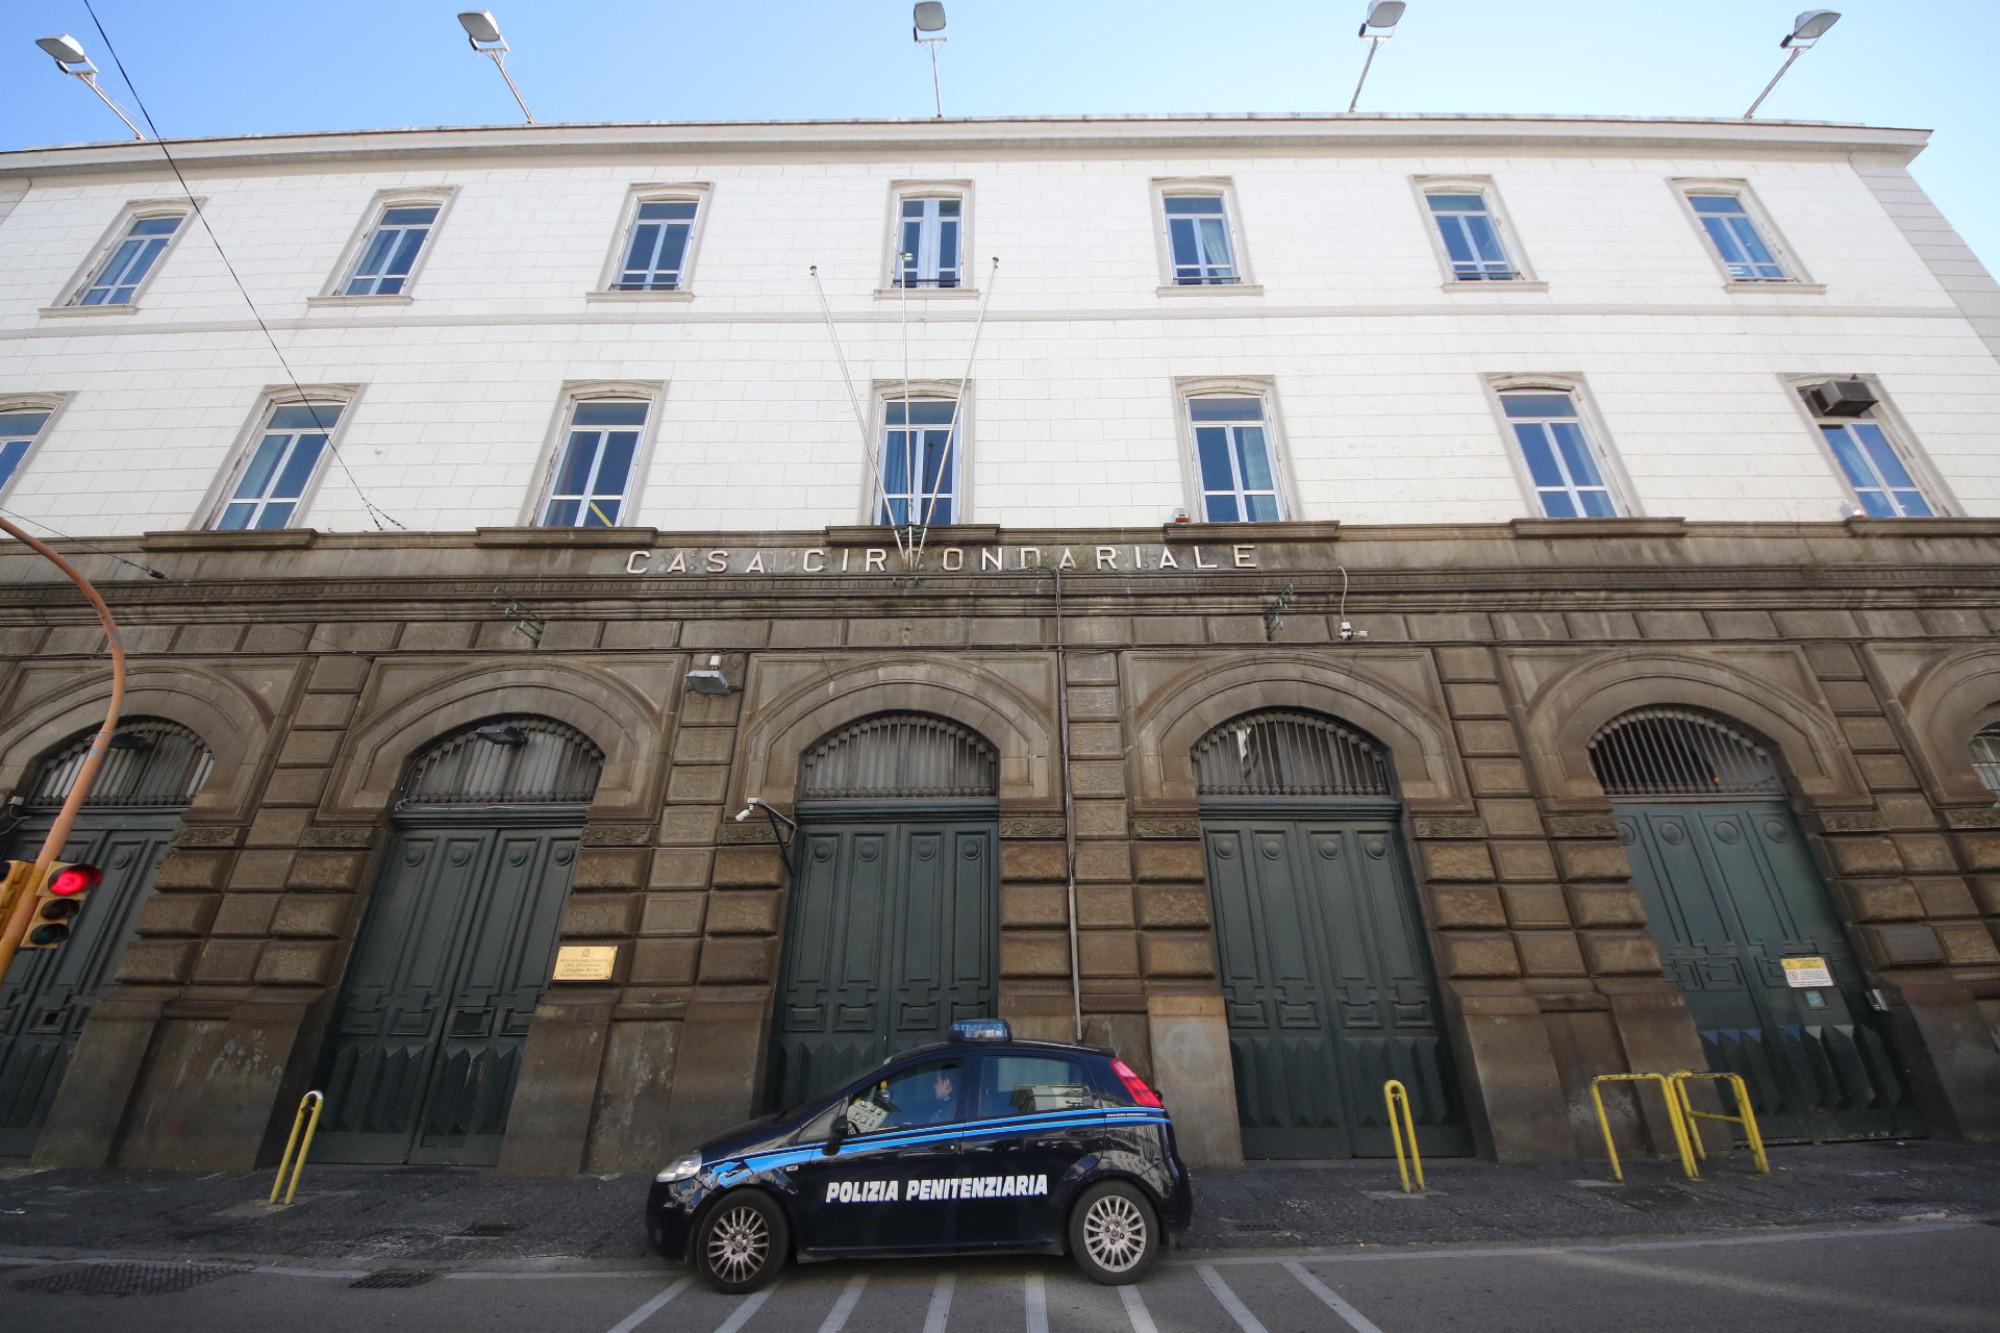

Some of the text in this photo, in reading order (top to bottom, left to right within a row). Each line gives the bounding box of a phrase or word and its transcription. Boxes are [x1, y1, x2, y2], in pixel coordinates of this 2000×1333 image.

[626, 551, 764, 574] CASA
[825, 1174, 1048, 1203] POLIZIA PENITENZIARIA
